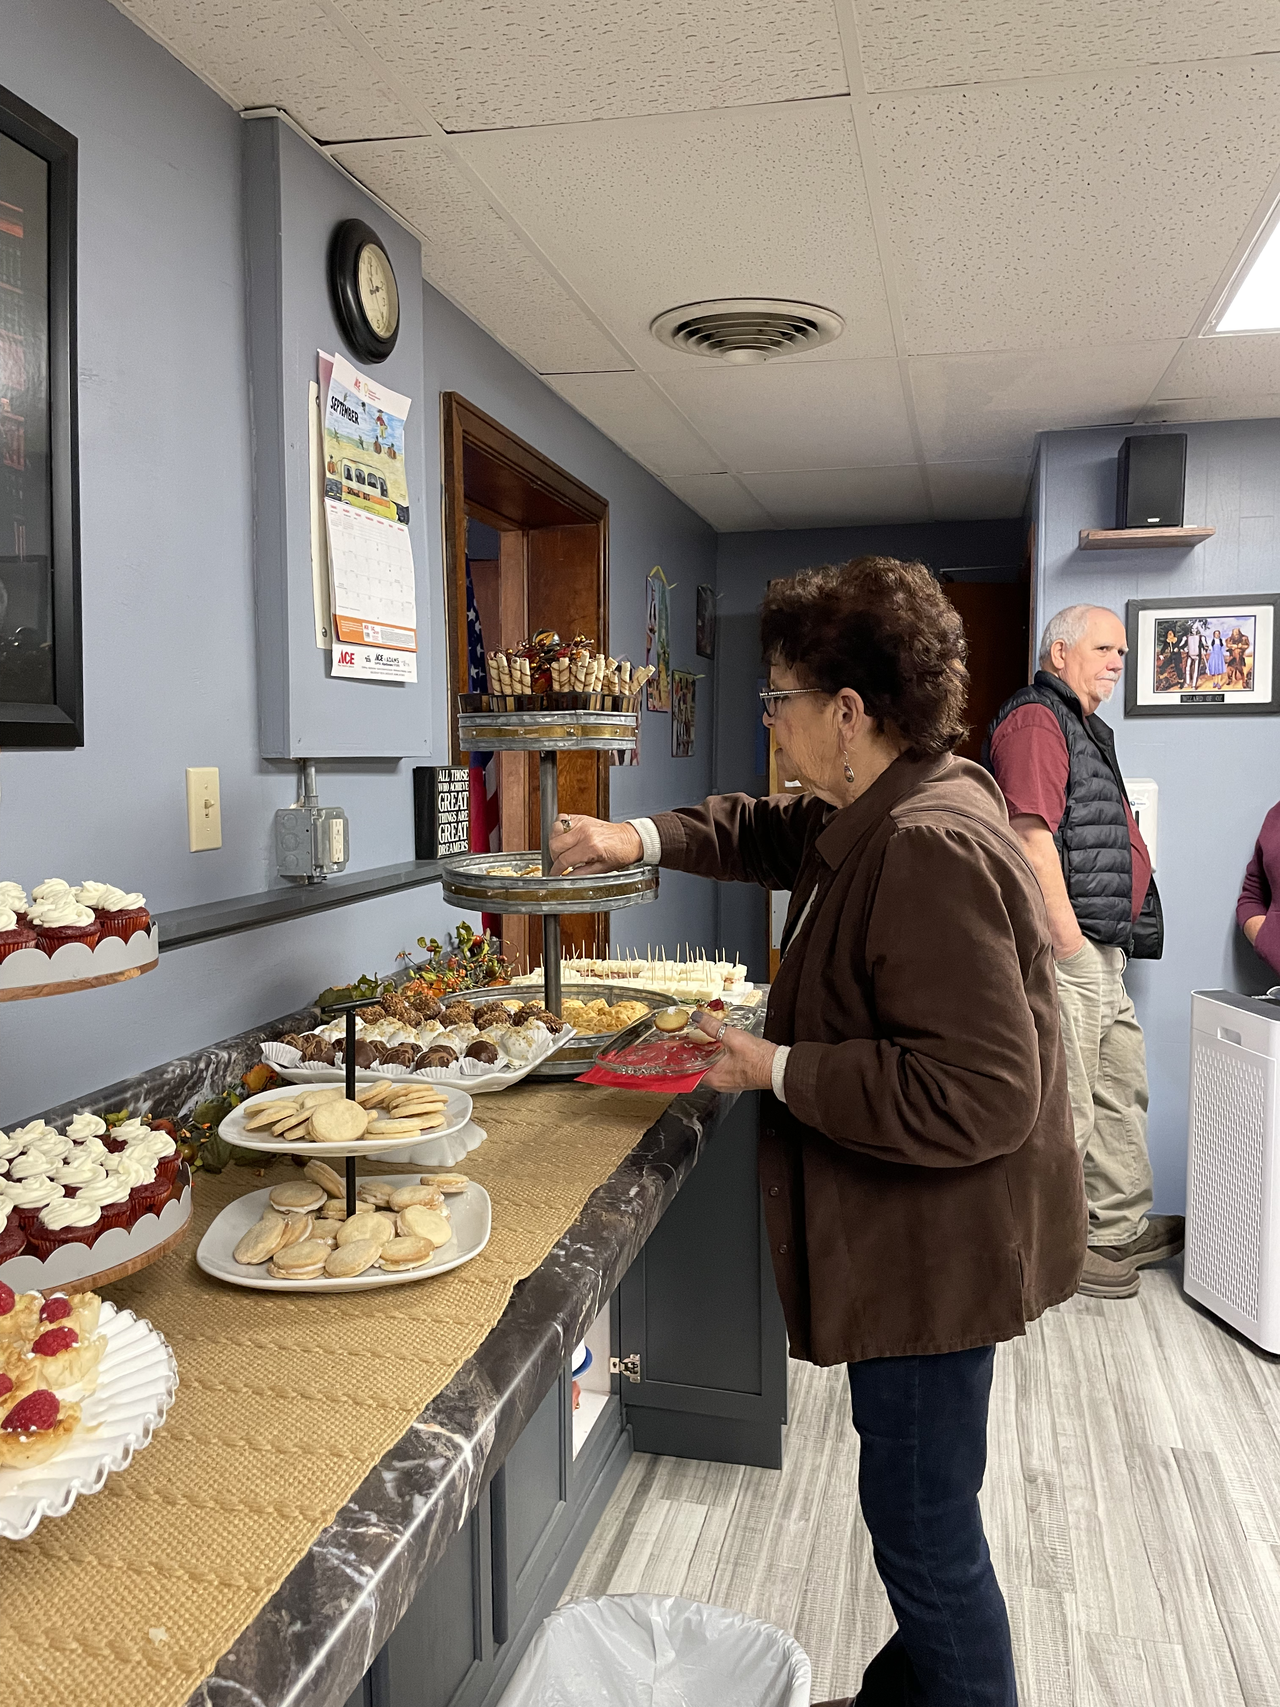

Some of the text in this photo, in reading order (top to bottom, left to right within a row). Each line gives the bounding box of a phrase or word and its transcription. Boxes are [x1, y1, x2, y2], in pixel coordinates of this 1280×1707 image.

[330, 396, 359, 425] SEPTEMBER
[338, 649, 355, 665] ACE
[438, 769, 469, 782] ALL THOSE
[438, 781, 469, 792] WHO ACHIEVE
[438, 792, 469, 812] GREAT
[439, 811, 469, 823] THINGS ARE
[438, 822, 469, 843] GREAT
[439, 840, 468, 855] DREAMERS
